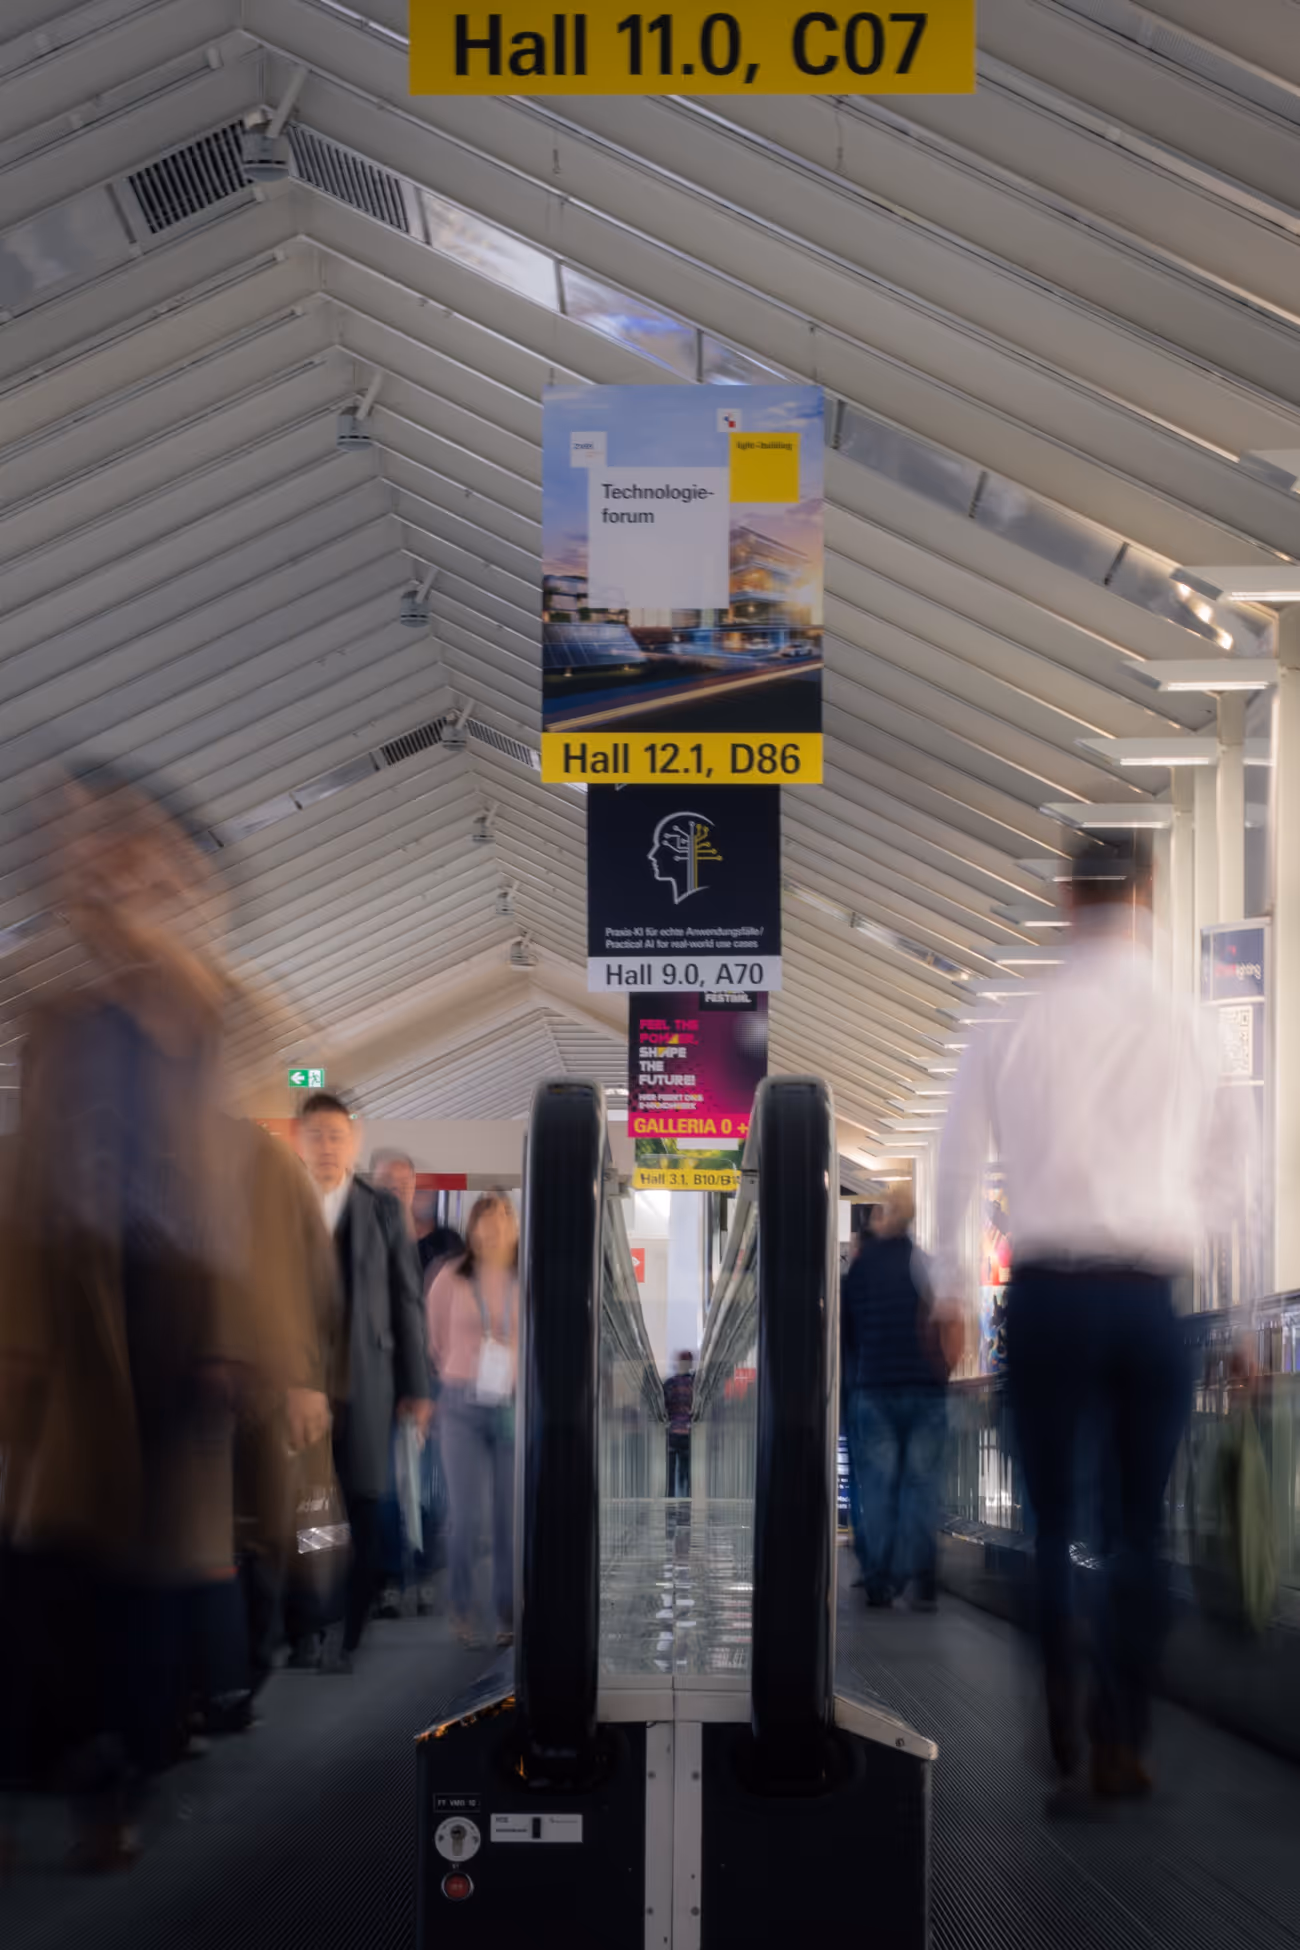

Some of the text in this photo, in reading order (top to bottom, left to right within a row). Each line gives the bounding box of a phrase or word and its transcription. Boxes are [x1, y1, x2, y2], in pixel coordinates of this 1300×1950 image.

[454, 12, 928, 85] Hall 11.0, C07
[602, 484, 715, 503] Technologie-
[602, 508, 654, 524] forum
[563, 743, 800, 778] Hall 12.1, D86
[605, 927, 644, 937] Praxis-KI
[645, 927, 658, 937] für
[659, 927, 684, 937] echte
[605, 939, 759, 949] Practical AI for real-world use cases
[606, 962, 764, 987] Hall 9.0, A70
[639, 1019, 699, 1031] FEEL THE
[639, 1046, 687, 1059] SHAPE
[639, 1060, 664, 1072] THE
[633, 1118, 717, 1134] GALLERIA
[721, 1118, 732, 1134] 0
[640, 1173, 665, 1185] Hall
